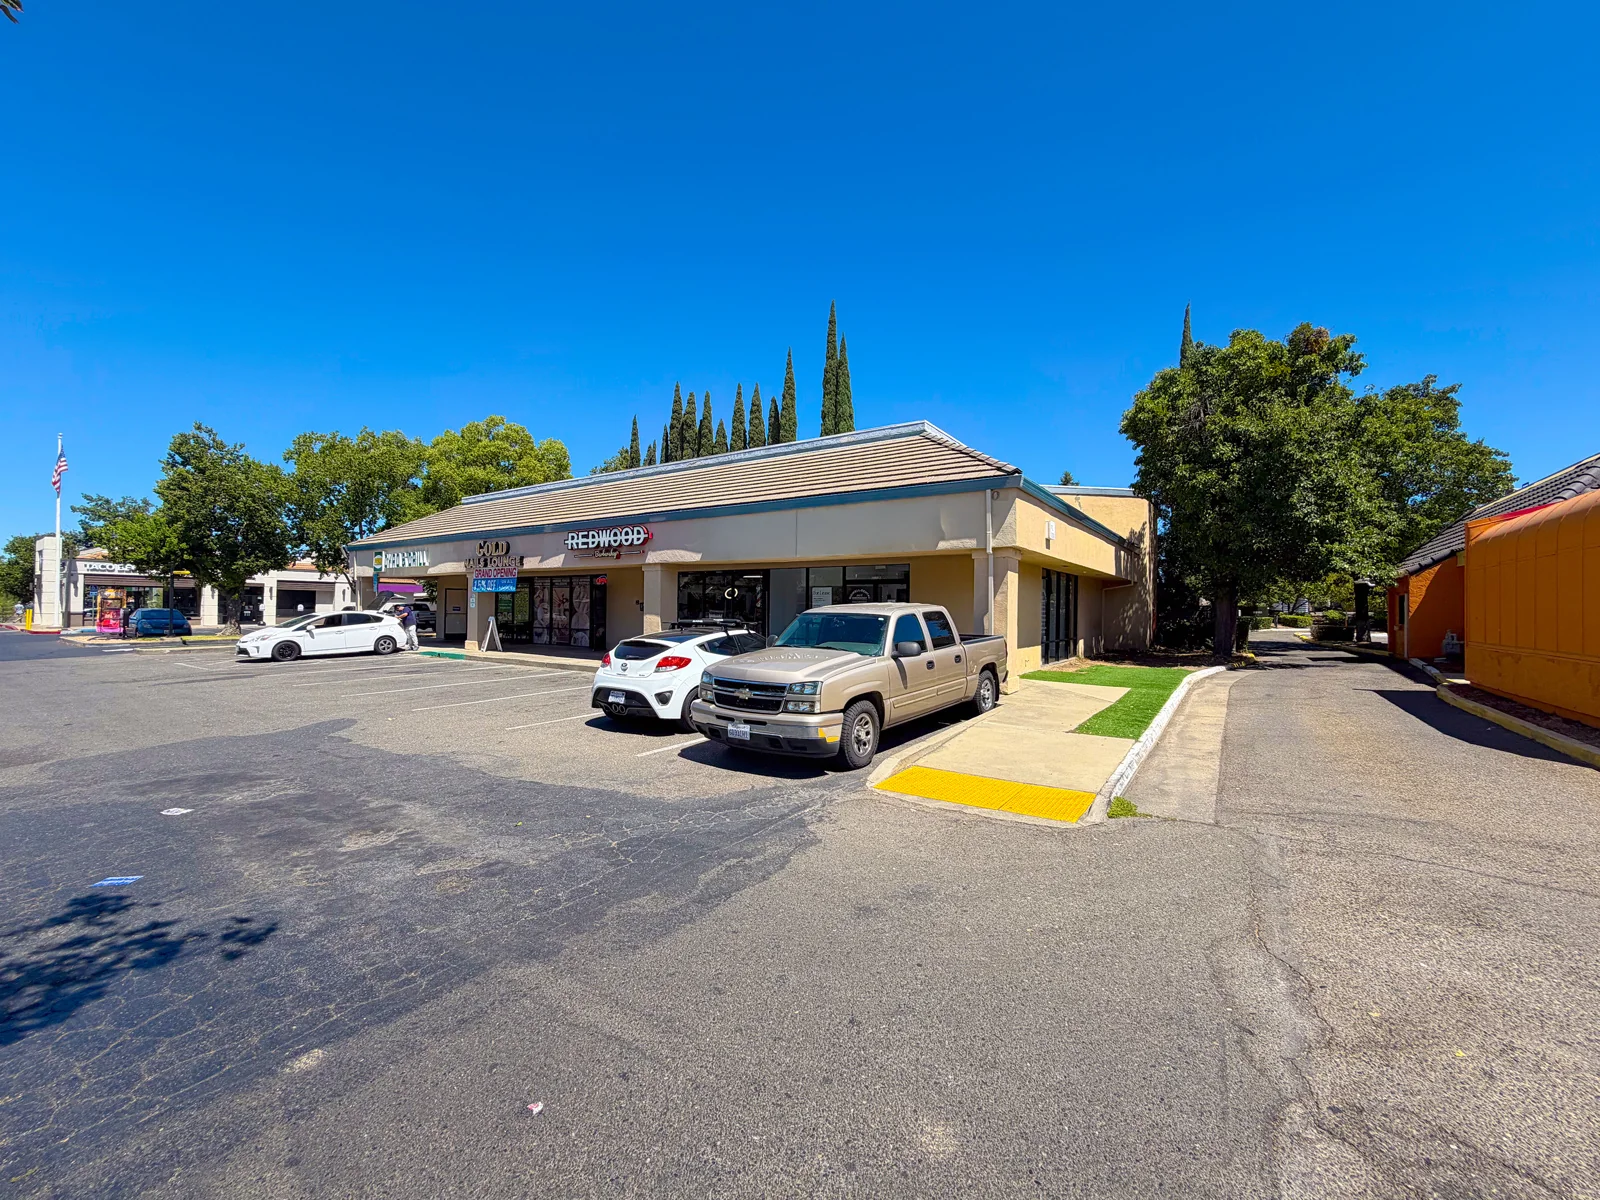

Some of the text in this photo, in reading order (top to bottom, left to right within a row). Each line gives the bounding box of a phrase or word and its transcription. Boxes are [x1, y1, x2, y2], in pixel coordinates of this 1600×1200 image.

[565, 526, 649, 549] REDWOOD
[475, 540, 508, 557] GOLD
[84, 563, 115, 573] TACO
[474, 567, 517, 578] GRAND OPENING
